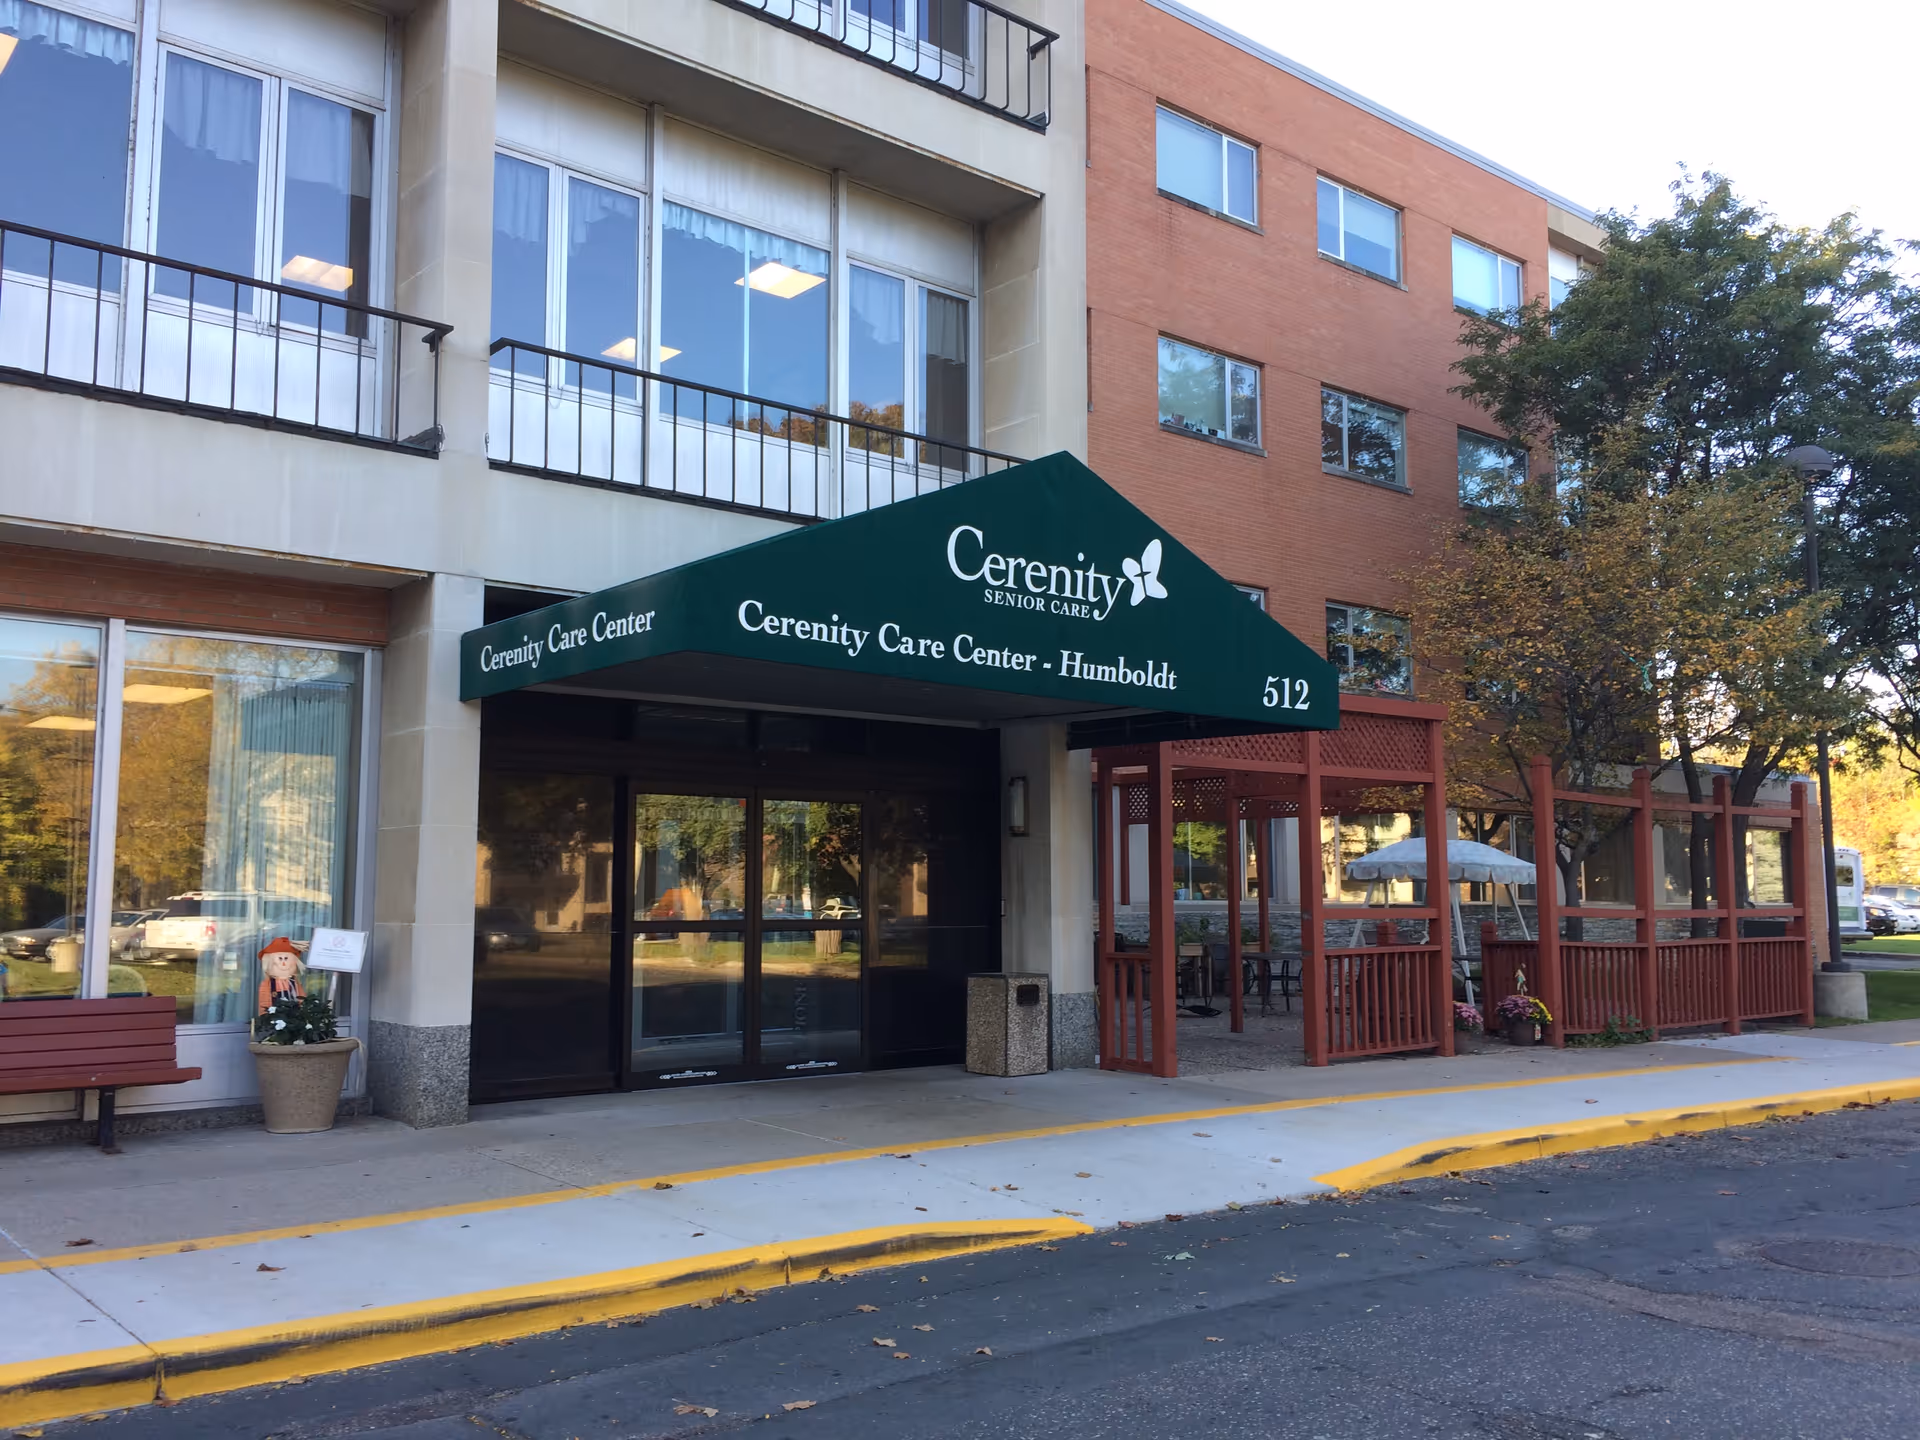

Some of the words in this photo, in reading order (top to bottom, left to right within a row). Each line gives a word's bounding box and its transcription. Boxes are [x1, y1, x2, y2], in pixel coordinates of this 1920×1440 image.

[947, 525, 1126, 621] Cerenity
[984, 588, 1046, 613] SENIOR
[1050, 600, 1090, 619] CARE
[480, 635, 544, 673] Cerenity
[547, 623, 588, 653] Care
[592, 609, 656, 642] Center
[738, 600, 870, 657] Cerenity
[878, 622, 945, 659] Care
[953, 633, 1037, 672] Center
[1058, 650, 1178, 690] Humboldt
[1262, 675, 1310, 711] 512
